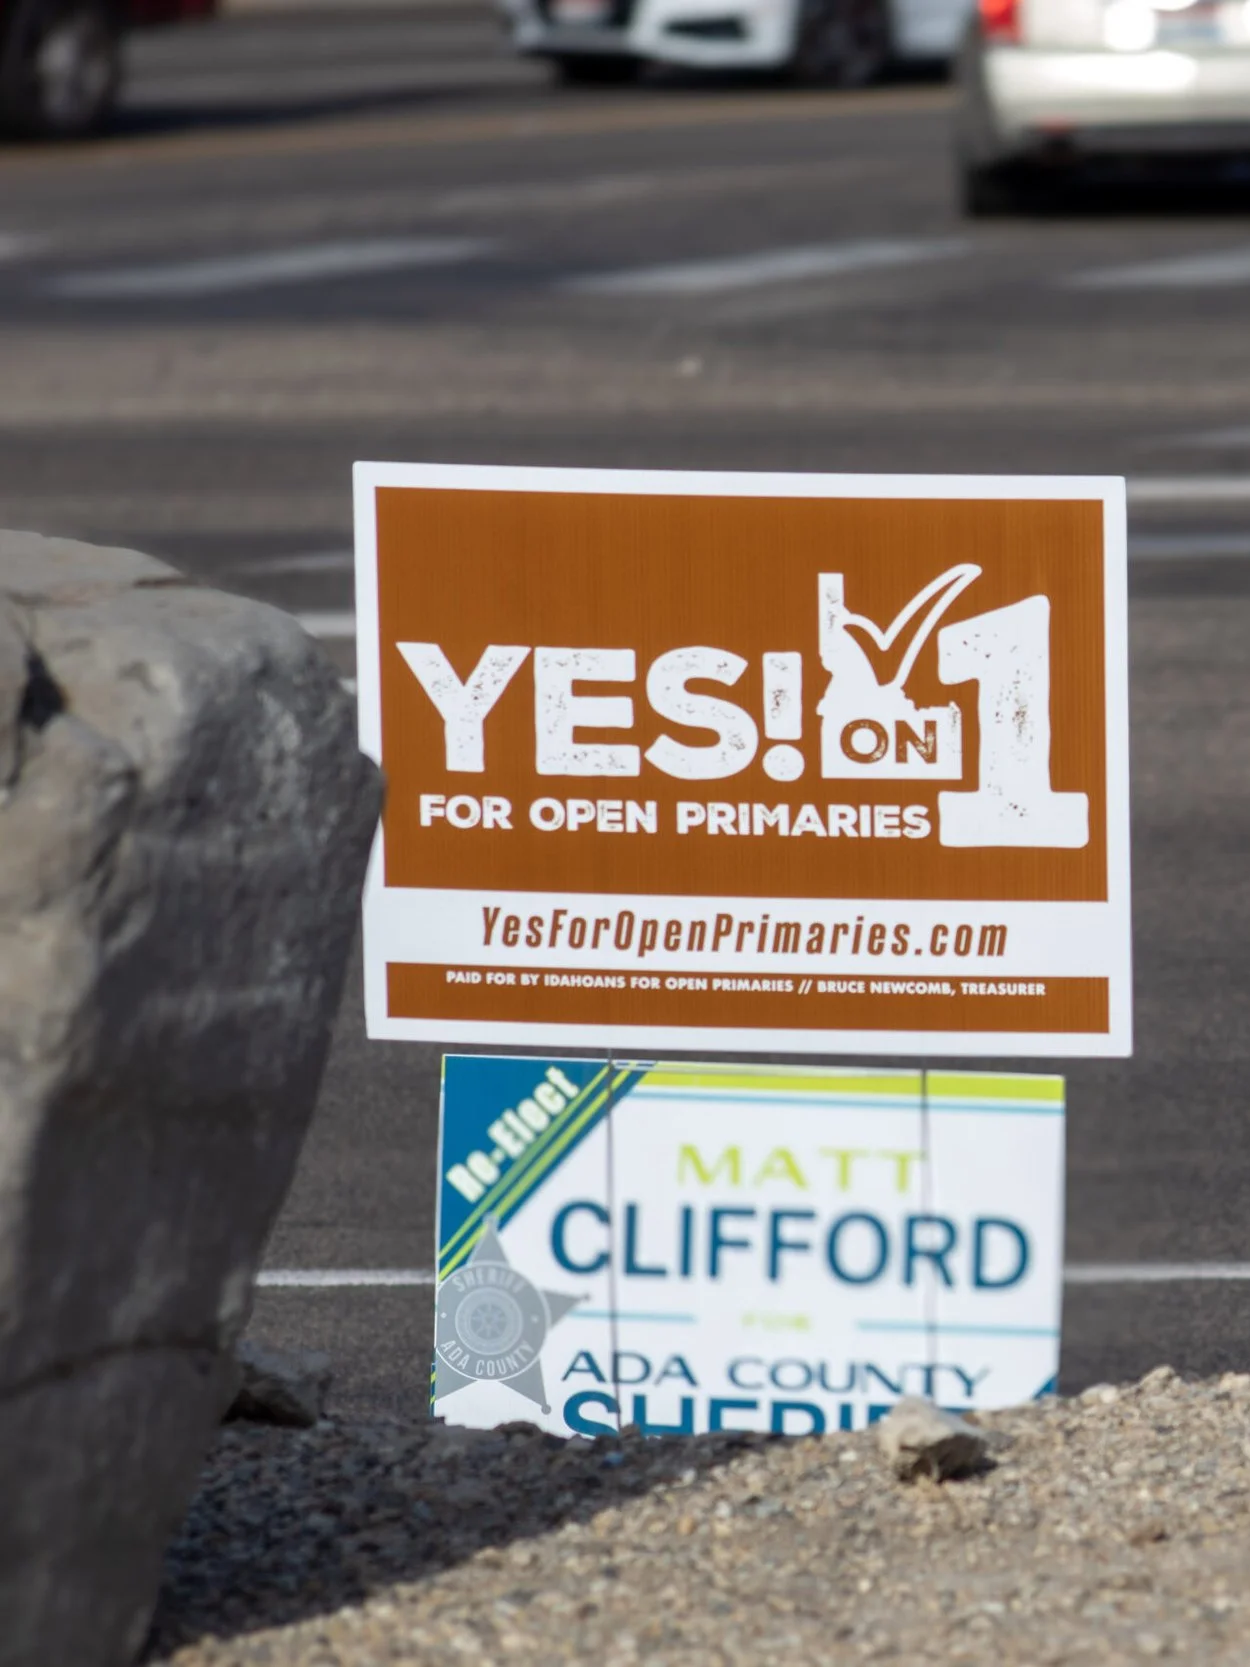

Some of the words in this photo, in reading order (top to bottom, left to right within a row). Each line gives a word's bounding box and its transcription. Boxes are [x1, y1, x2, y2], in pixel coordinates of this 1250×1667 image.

[396, 641, 805, 782] YES!
[839, 719, 938, 765] ON
[938, 594, 1089, 848] 1
[419, 794, 513, 830] FOR
[529, 798, 658, 834] OPEN
[676, 802, 931, 839] PRIMARIES
[481, 906, 1008, 958] YesForOpenPrimaries.com
[446, 970, 482, 984] PAID
[486, 972, 516, 986] FOR
[520, 973, 540, 986] BY
[544, 974, 626, 989] IDAHOANS
[630, 977, 660, 989] FOR
[665, 978, 707, 991] OPEN
[712, 979, 794, 993] PRIMARIES
[817, 981, 865, 994] BRUCE
[870, 982, 956, 997] NEWCOMB,
[961, 983, 1046, 996] TREASURER
[445, 1065, 580, 1203] Re-Elect
[677, 1144, 928, 1193] MATT
[550, 1200, 1032, 1293] CLIFFORD
[440, 1340, 471, 1370] ADA
[475, 1340, 533, 1376] COUNTY
[562, 1349, 699, 1388] ADA
[727, 1357, 992, 1398] COUNTY
